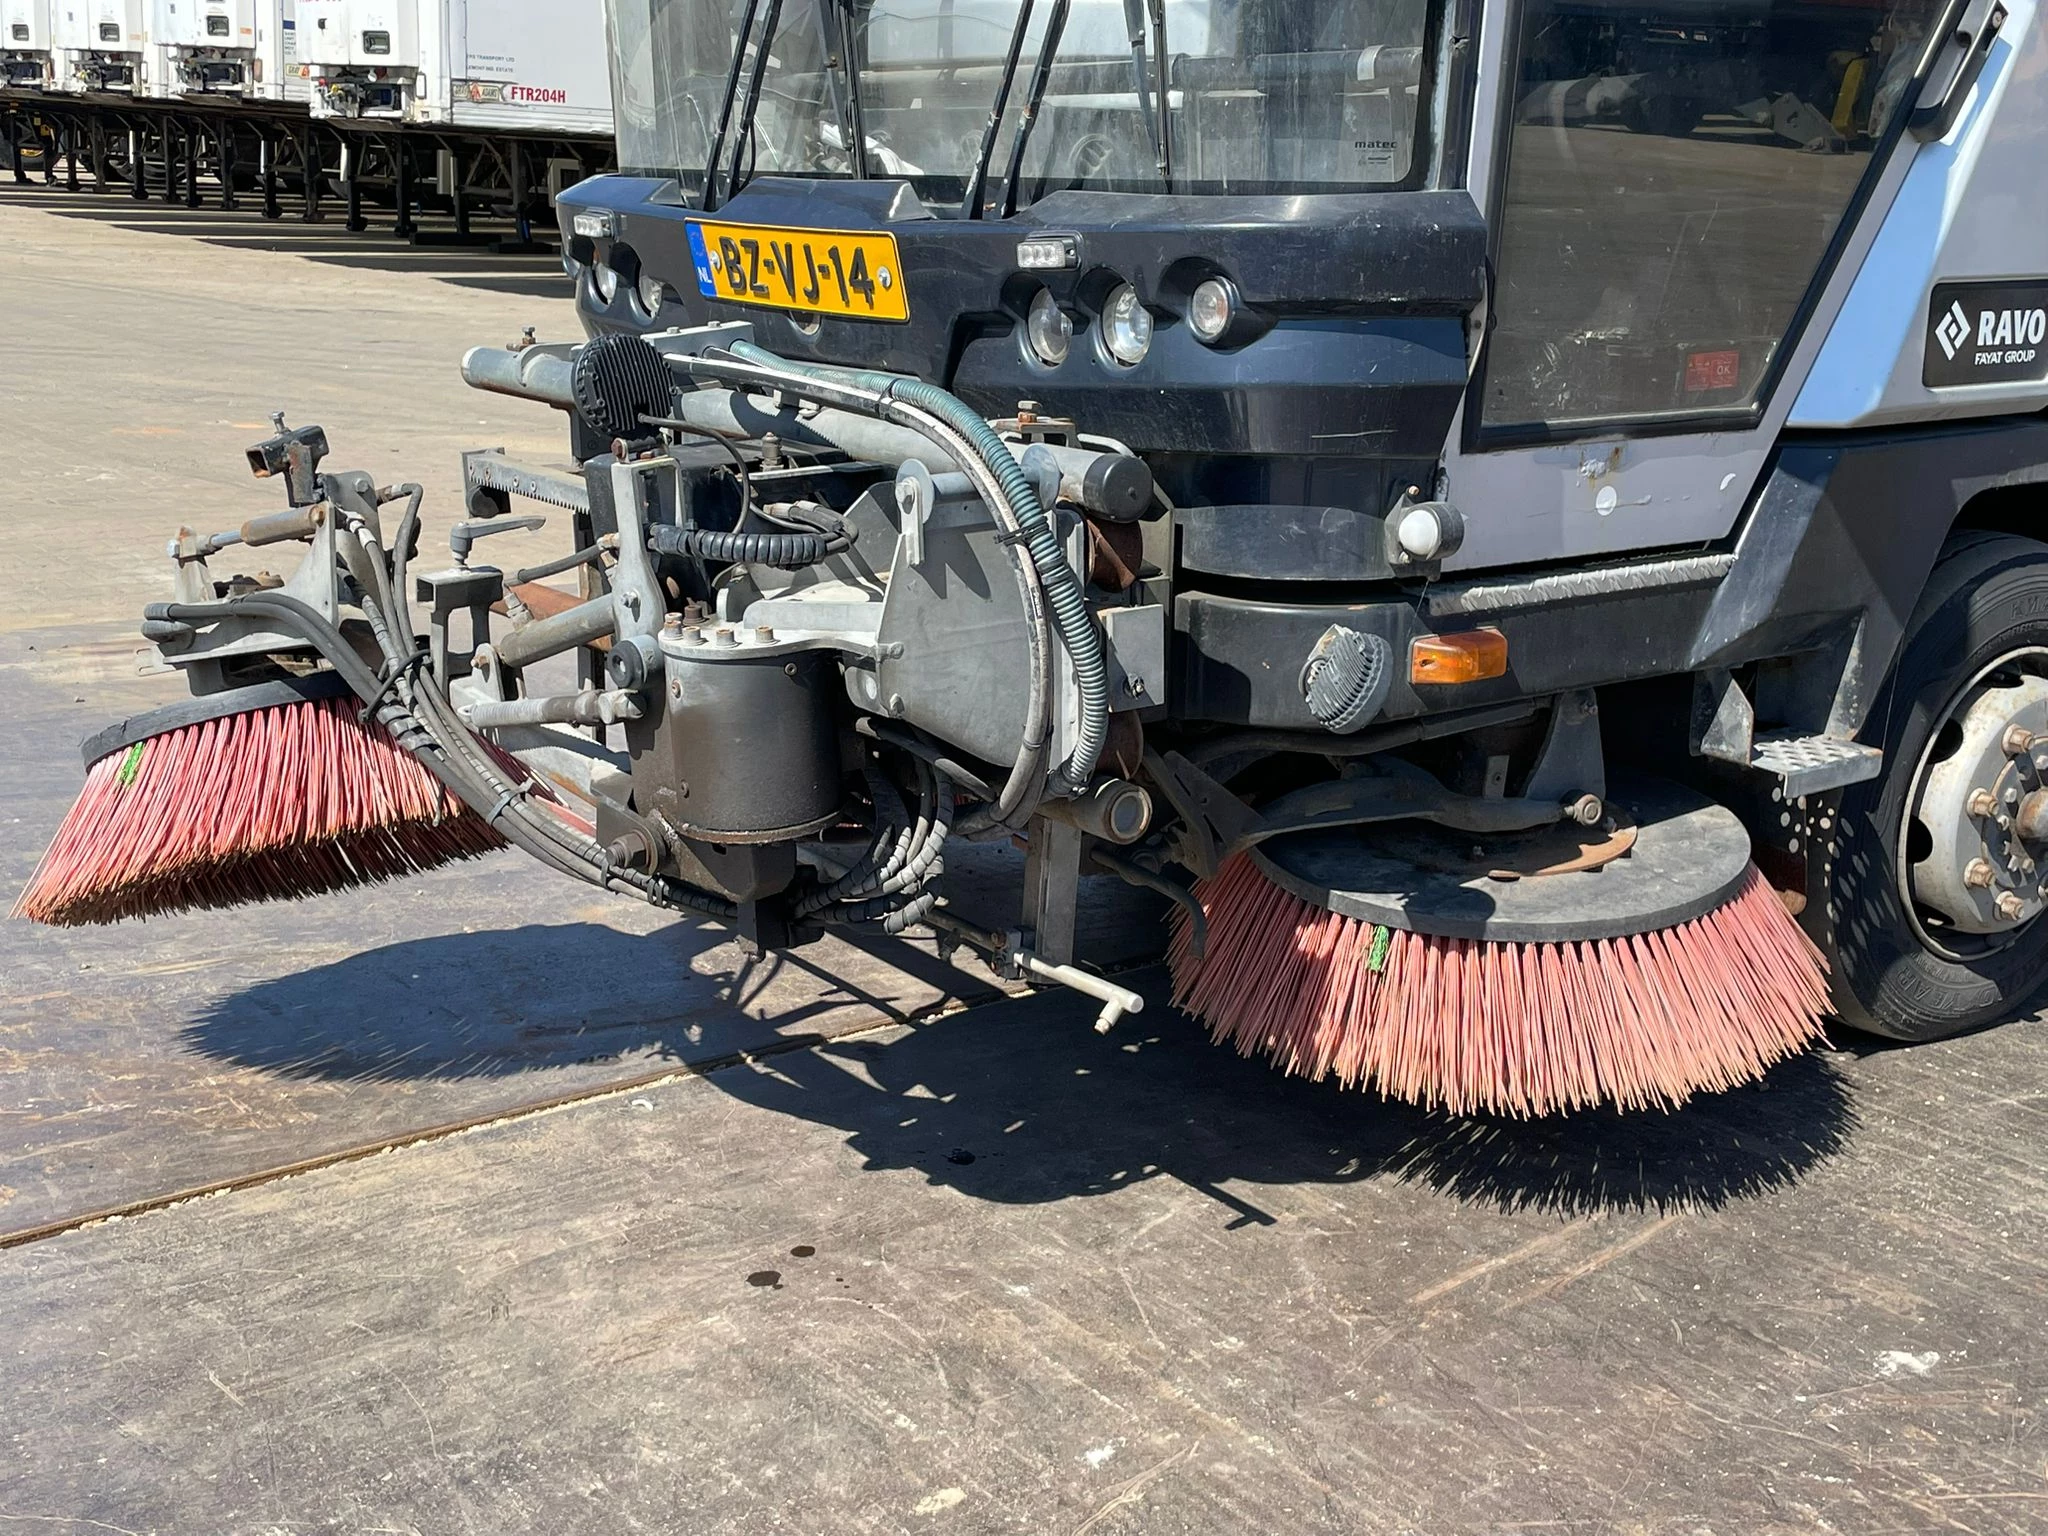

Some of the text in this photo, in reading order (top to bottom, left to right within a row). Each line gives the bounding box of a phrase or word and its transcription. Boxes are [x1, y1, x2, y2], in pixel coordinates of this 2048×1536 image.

[511, 86, 566, 104] FTR204H
[1354, 140, 1398, 149] matec
[698, 267, 713, 283] NL
[719, 235, 875, 309] BZ-VJ-14
[1976, 308, 2047, 346] RAVO
[1974, 349, 2036, 365] FAYAT GROUP
